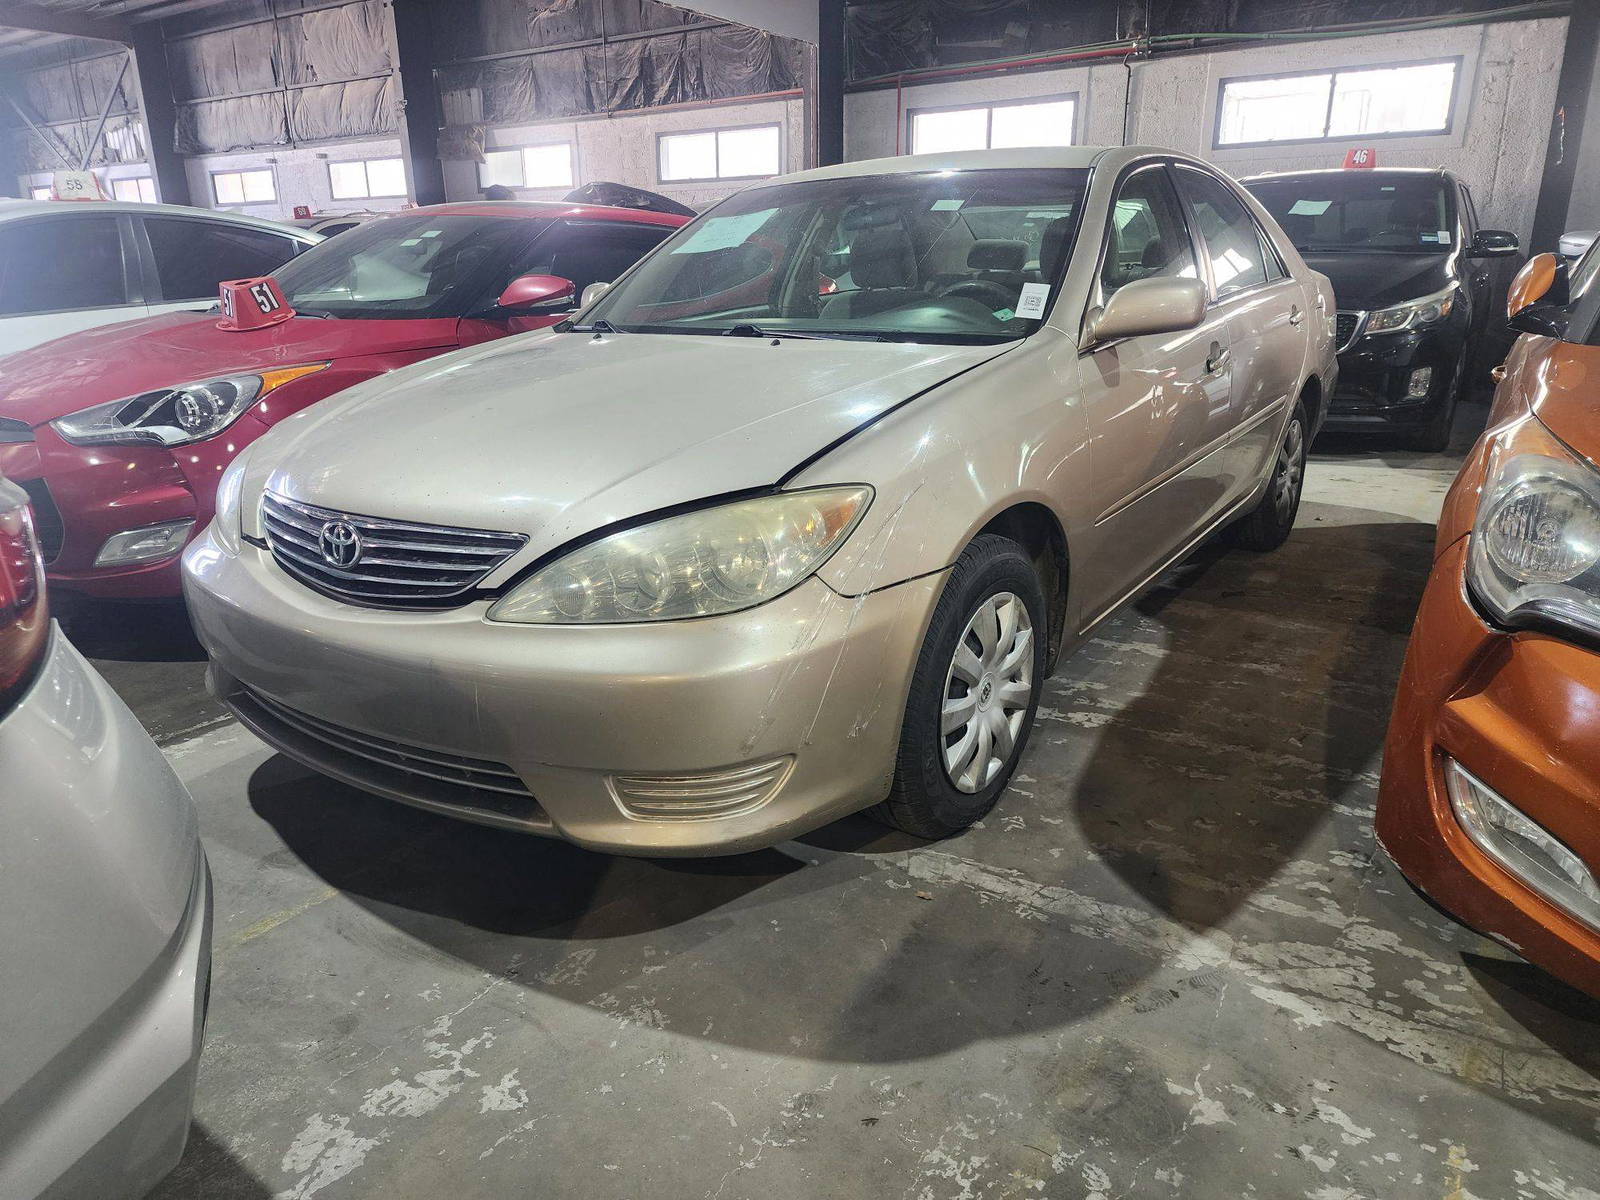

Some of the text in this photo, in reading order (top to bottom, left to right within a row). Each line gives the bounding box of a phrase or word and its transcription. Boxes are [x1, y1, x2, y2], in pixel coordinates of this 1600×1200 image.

[1353, 149, 1368, 164] 46
[223, 287, 234, 318] 51
[250, 282, 279, 313] 51
